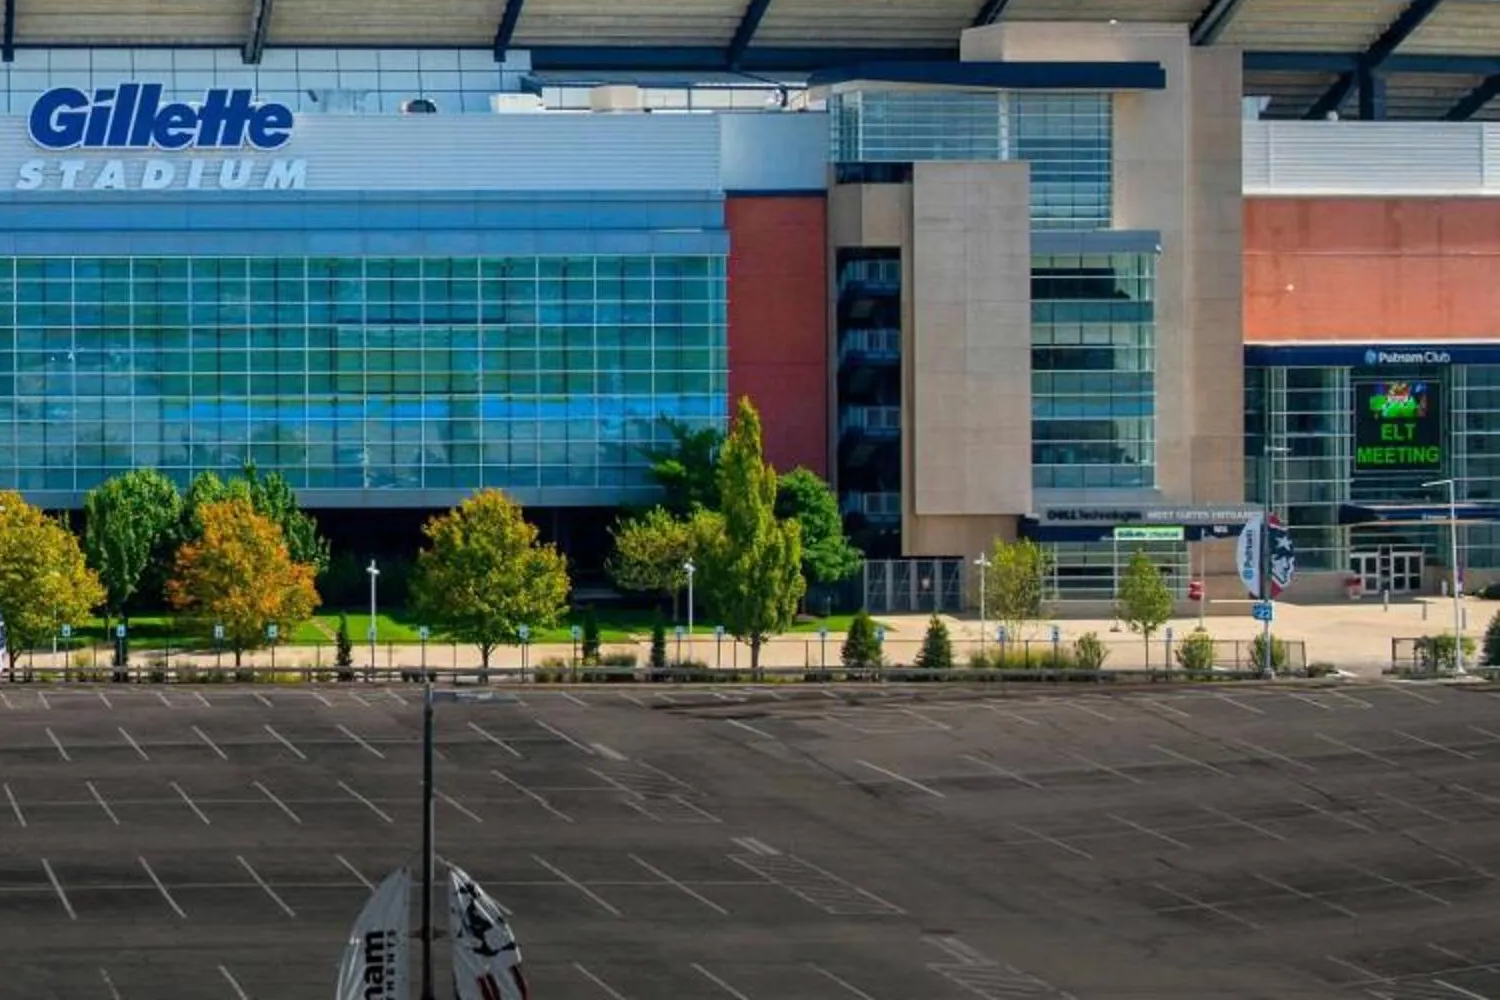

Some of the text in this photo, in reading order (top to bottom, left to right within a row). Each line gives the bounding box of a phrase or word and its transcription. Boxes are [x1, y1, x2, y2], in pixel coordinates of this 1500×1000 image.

[28, 83, 294, 150] Gillette
[15, 158, 308, 190] STADIUM
[1378, 351, 1451, 363] Putnam Club
[1381, 423, 1416, 440] ELT
[1357, 446, 1440, 464] MEETING
